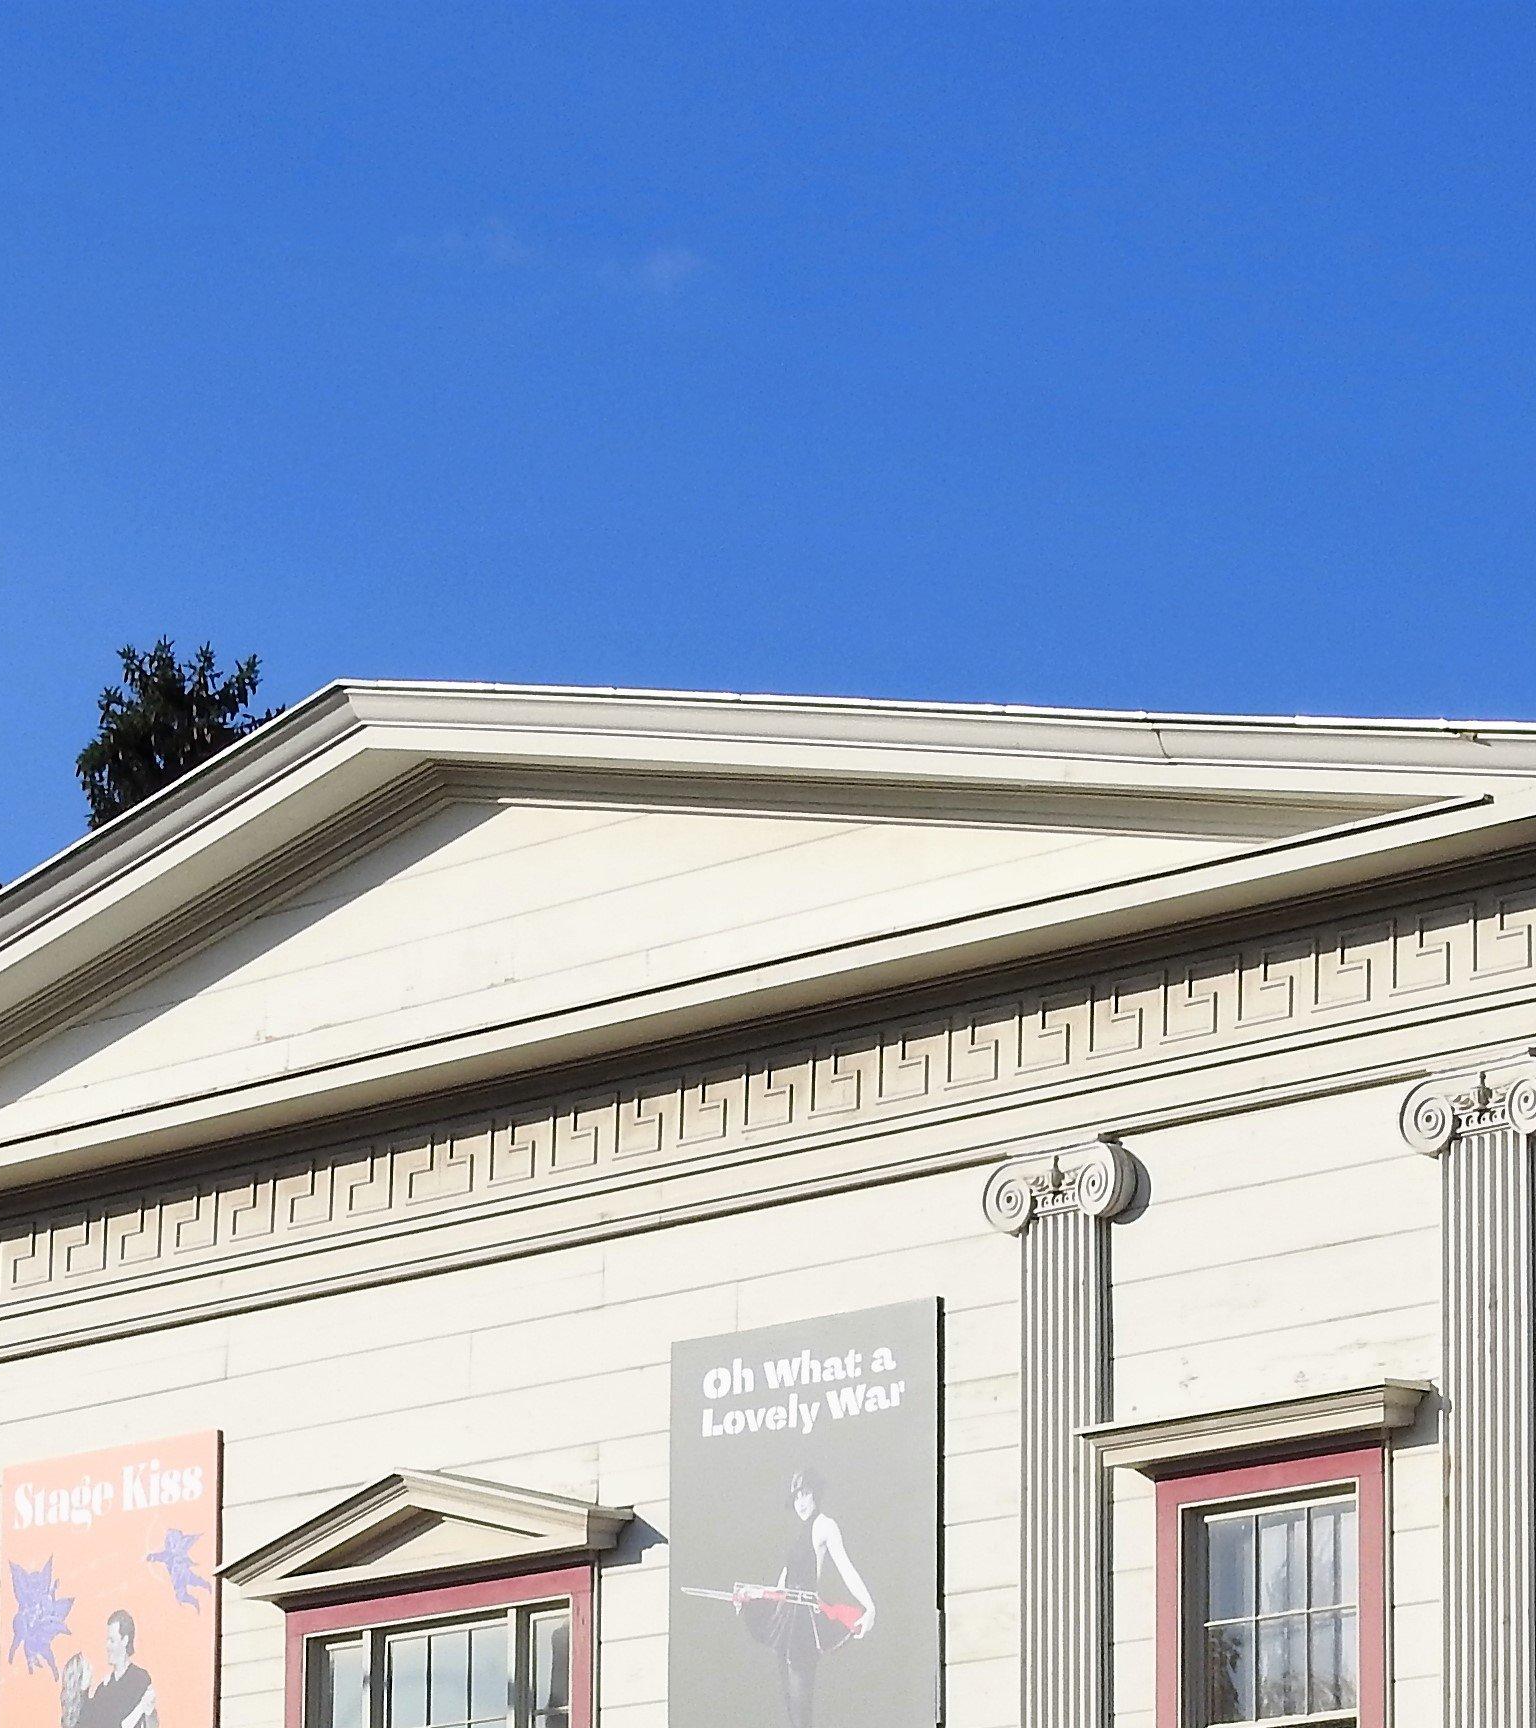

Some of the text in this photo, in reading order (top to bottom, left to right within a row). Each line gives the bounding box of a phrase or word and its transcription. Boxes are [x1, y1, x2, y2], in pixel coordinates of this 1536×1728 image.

[703, 1347, 897, 1400] Oh What a
[702, 1380, 906, 1438] Lovely War
[12, 1458, 205, 1532] Stage Kiss
